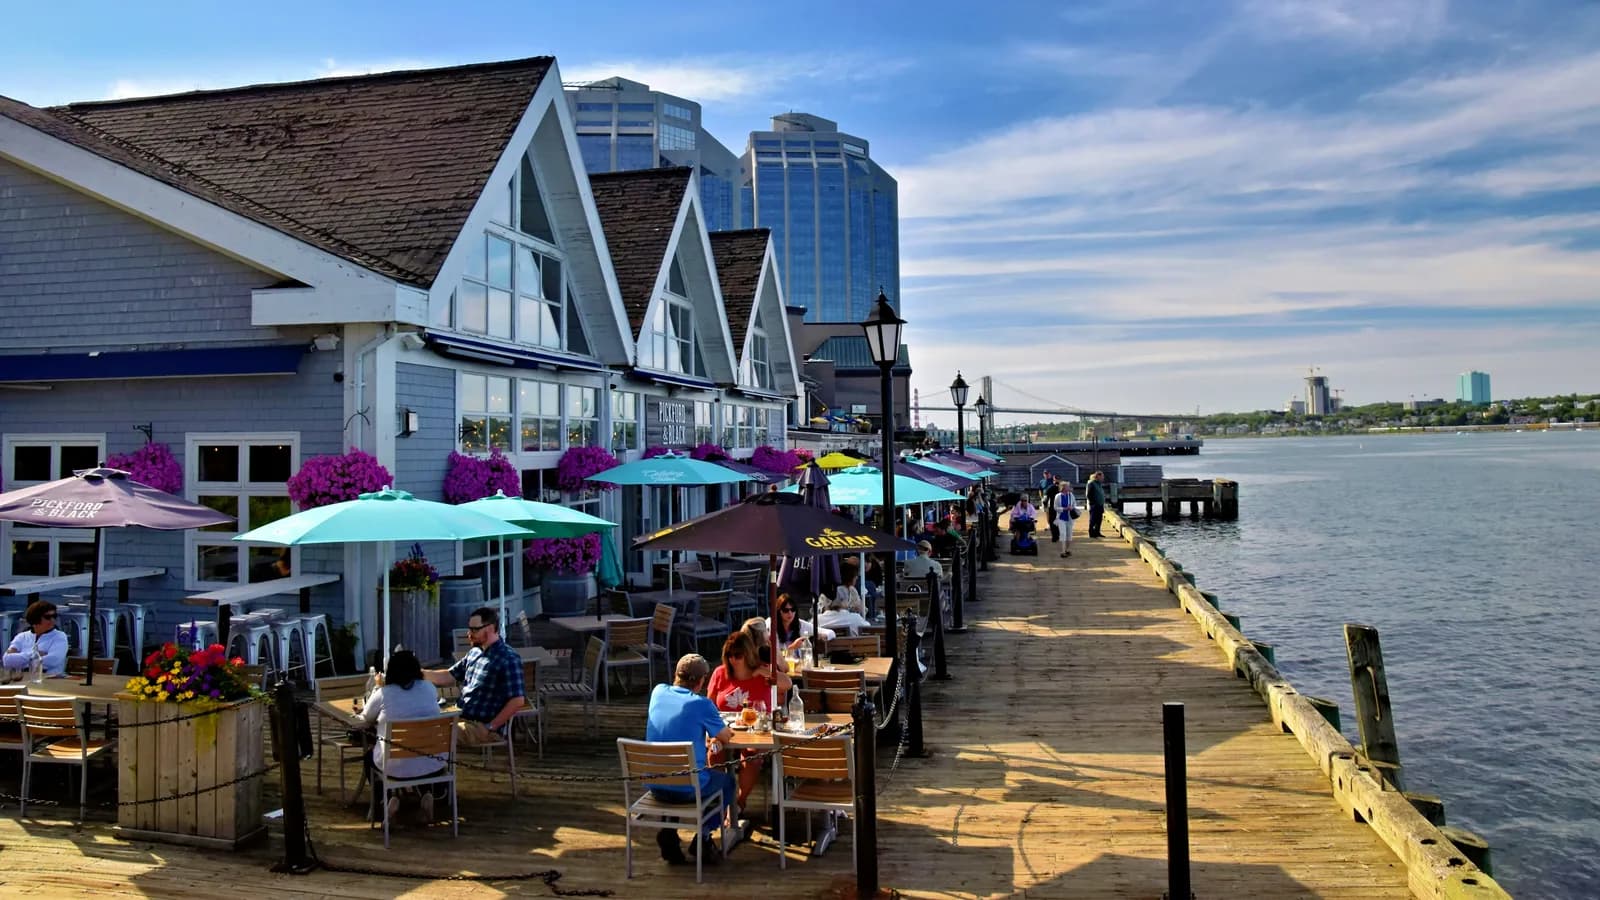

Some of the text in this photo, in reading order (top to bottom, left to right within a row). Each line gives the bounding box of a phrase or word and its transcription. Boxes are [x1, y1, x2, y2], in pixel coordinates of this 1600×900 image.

[31, 498, 104, 511] PICKFORD
[48, 509, 99, 518] BLACK
[804, 535, 877, 548] GAHAN
